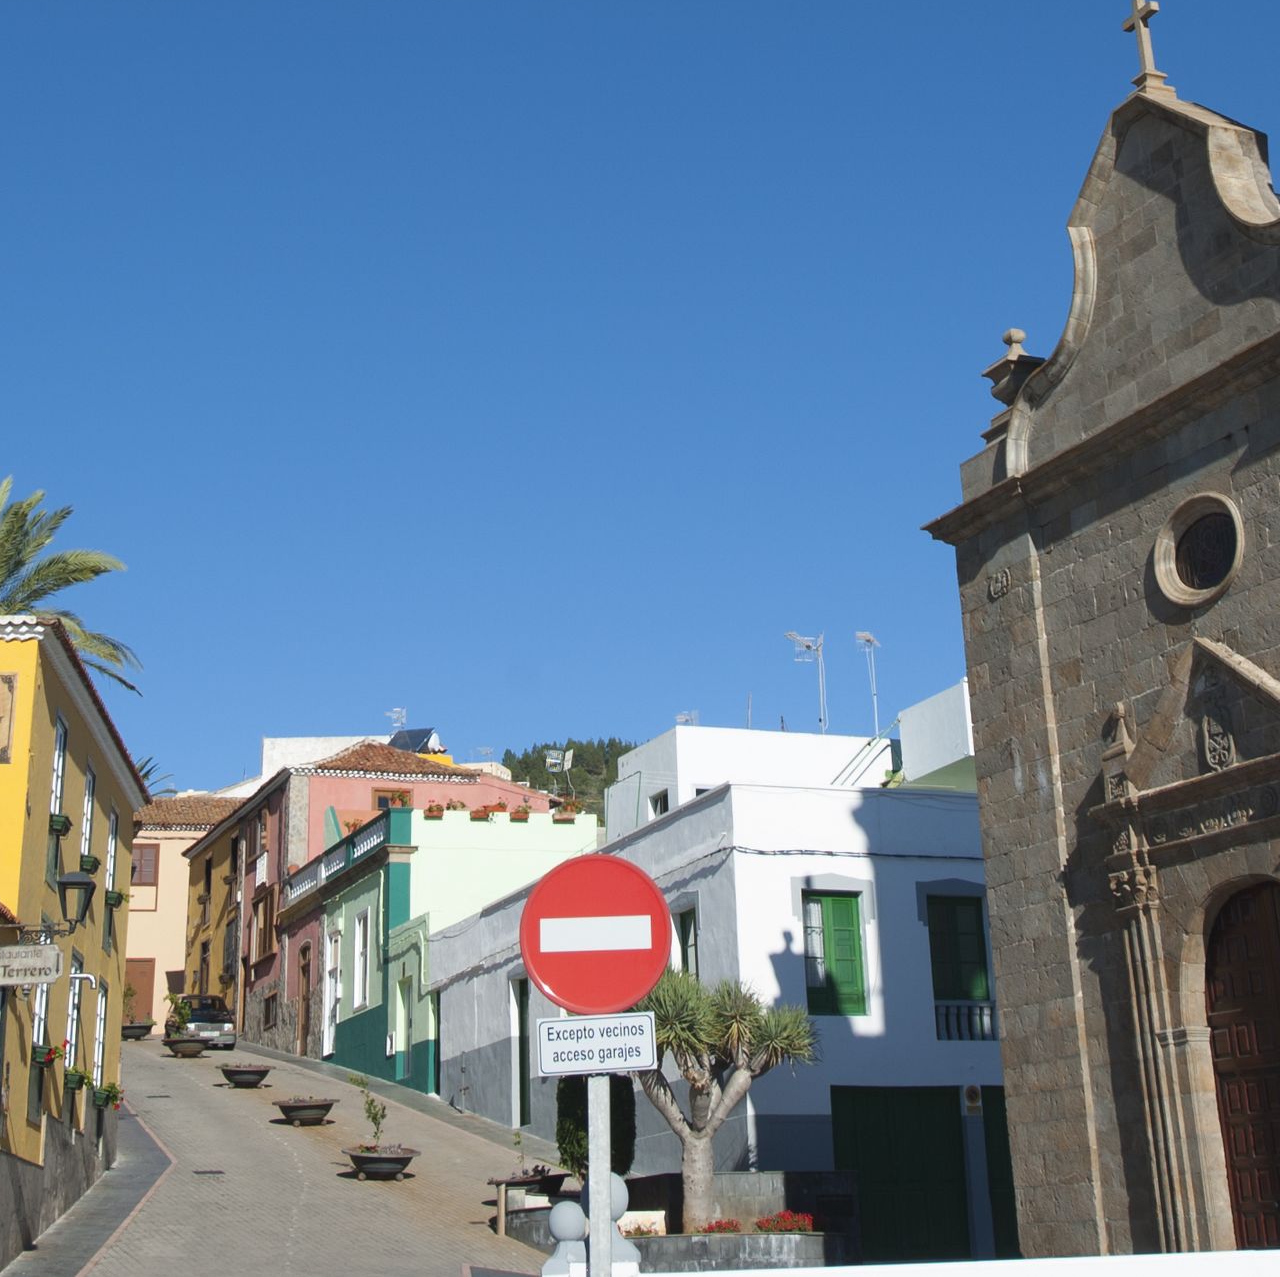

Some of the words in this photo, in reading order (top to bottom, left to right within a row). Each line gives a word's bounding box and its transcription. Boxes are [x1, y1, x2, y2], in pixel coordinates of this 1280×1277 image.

[0, 964, 52, 978] Terrero
[547, 1025, 595, 1043] Excepto
[599, 1022, 645, 1038] vecinos
[552, 1049, 595, 1063] acceso
[598, 1043, 641, 1064] garajes
